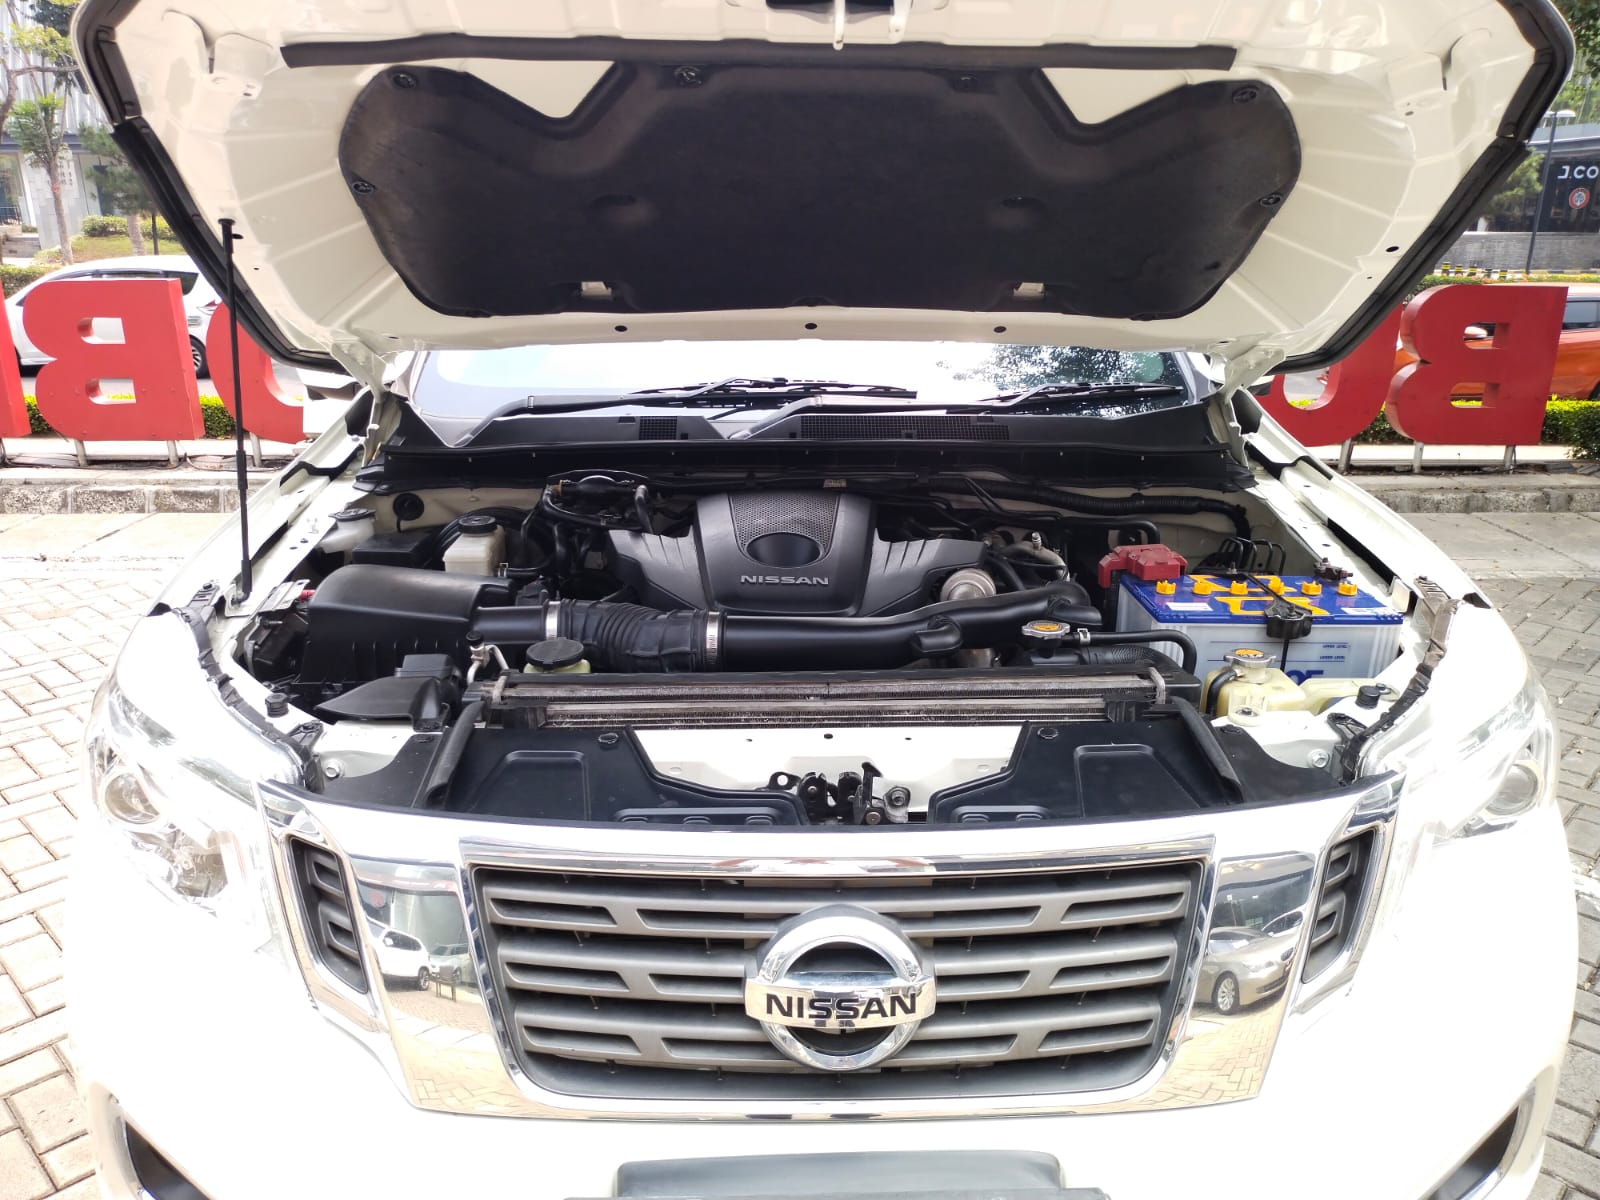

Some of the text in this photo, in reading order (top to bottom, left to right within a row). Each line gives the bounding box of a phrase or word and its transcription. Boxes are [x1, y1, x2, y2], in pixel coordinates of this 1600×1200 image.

[1557, 165, 1599, 179] J.CO
[740, 575, 829, 585] NISSAN
[766, 992, 917, 1020] NISSAN
